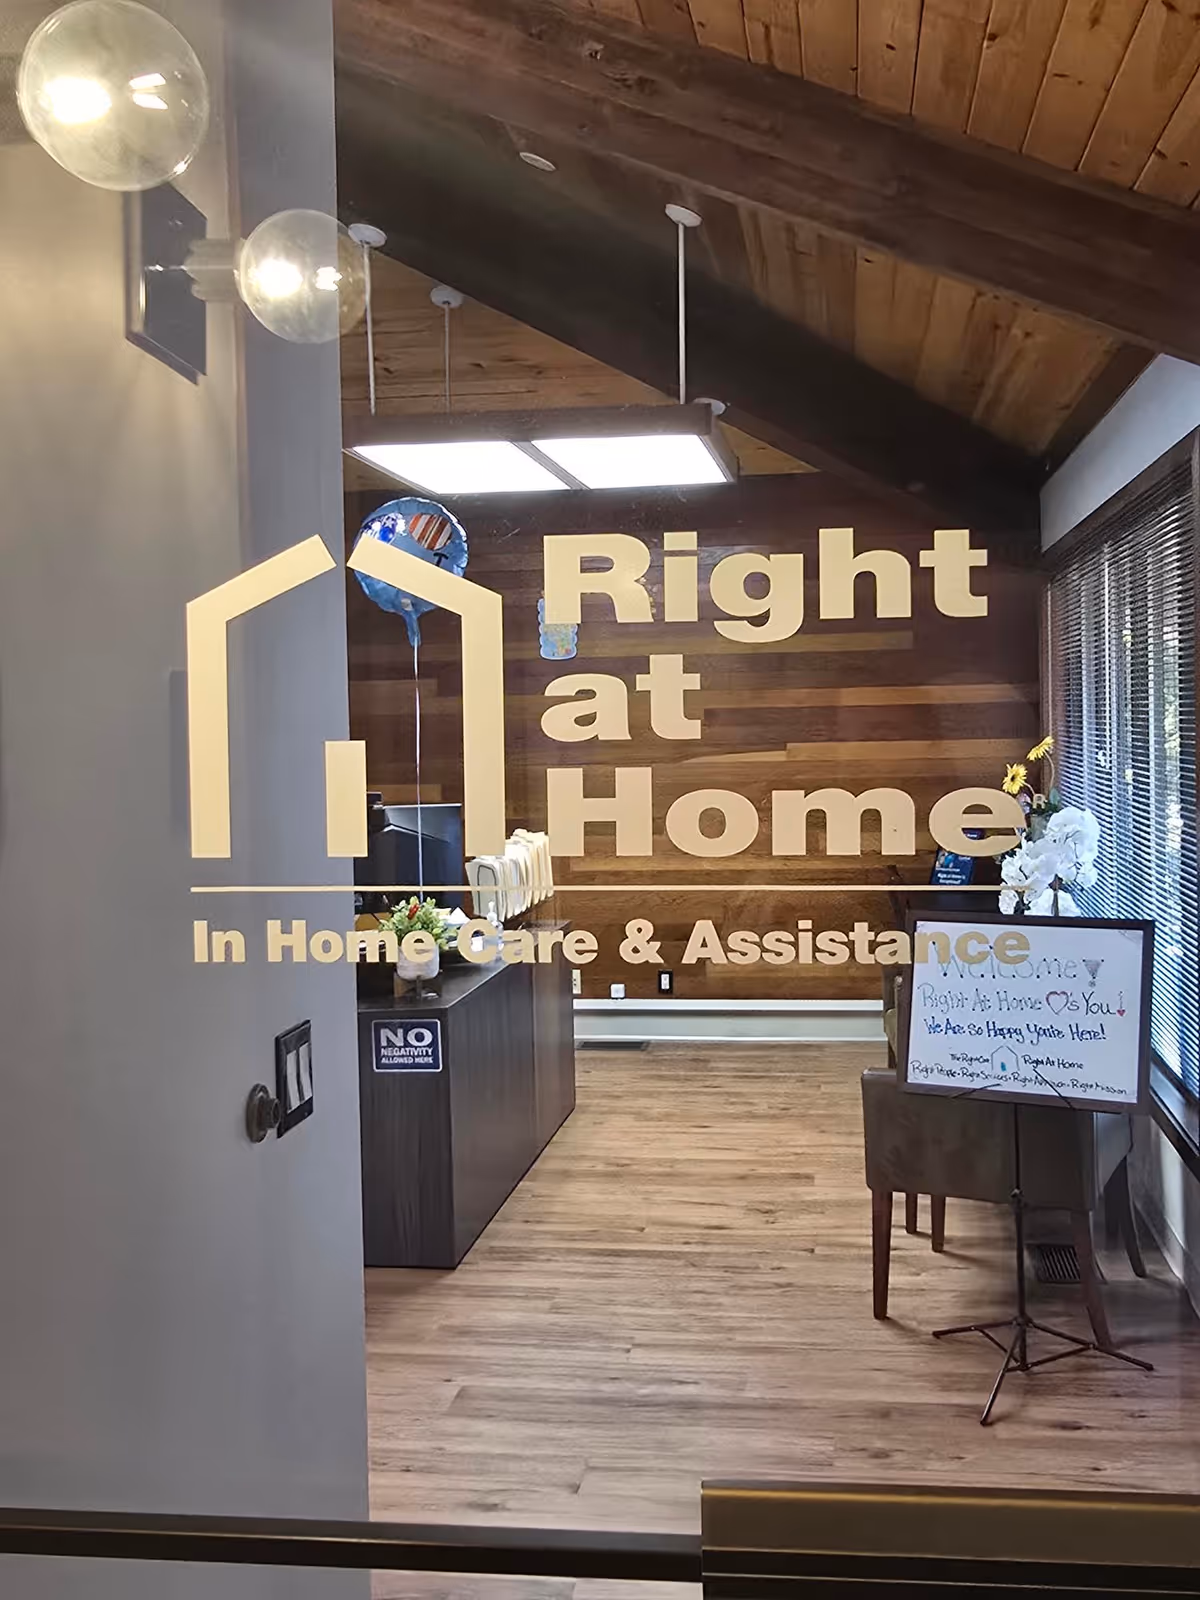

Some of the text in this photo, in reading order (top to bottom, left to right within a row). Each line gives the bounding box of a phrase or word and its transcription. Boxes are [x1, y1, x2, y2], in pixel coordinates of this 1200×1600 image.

[543, 528, 989, 643] Right
[540, 654, 702, 742] at
[546, 766, 1028, 857] Home
[193, 918, 1031, 966] In Home Care & Assistance
[917, 983, 969, 1015] Right
[971, 988, 992, 1012] At
[995, 990, 1042, 1012] Home
[380, 1027, 433, 1047] NO
[923, 1016, 943, 1035] We
[944, 1018, 966, 1036] Are
[967, 1022, 984, 1036] So
[985, 1020, 1025, 1044] Happy
[1068, 1022, 1107, 1042] Here!
[380, 1047, 433, 1056] NEGATIVITY
[381, 1056, 433, 1064] ALLOWED HERE
[1057, 1057, 1084, 1070] Home
